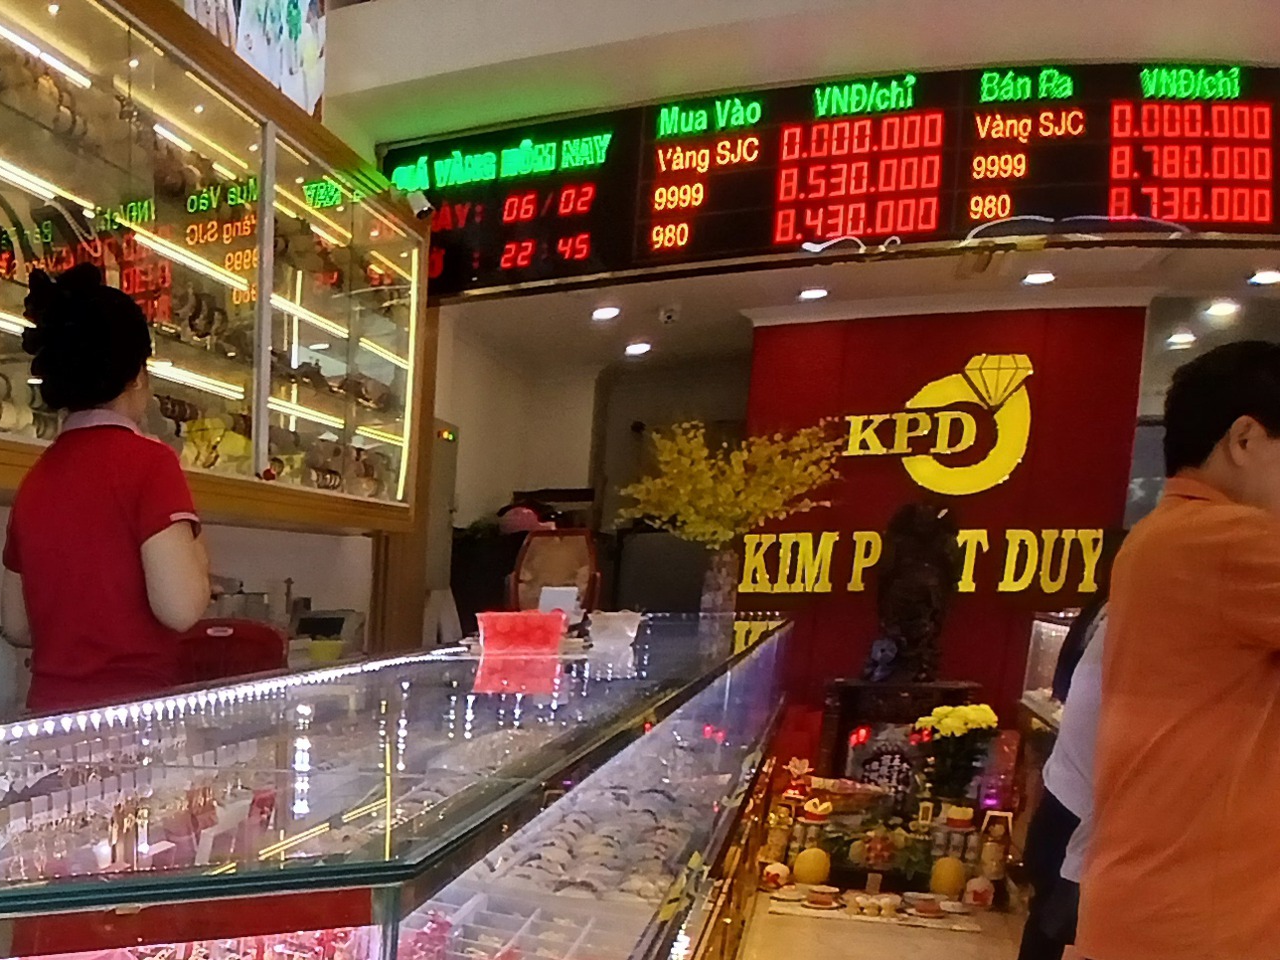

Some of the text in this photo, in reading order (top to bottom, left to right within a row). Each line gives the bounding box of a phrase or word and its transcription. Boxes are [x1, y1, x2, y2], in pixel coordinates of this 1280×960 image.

[658, 97, 762, 135] Mua Vào
[975, 110, 1085, 143] Vàng SJC
[658, 136, 760, 173] Vàng SJC
[972, 153, 1027, 179] 9999
[654, 182, 704, 210] 9999
[969, 194, 1011, 219] 980
[652, 222, 689, 249] 980
[843, 410, 977, 456] KPD
[738, 531, 840, 593] KIM
[997, 528, 1104, 593] DUY
